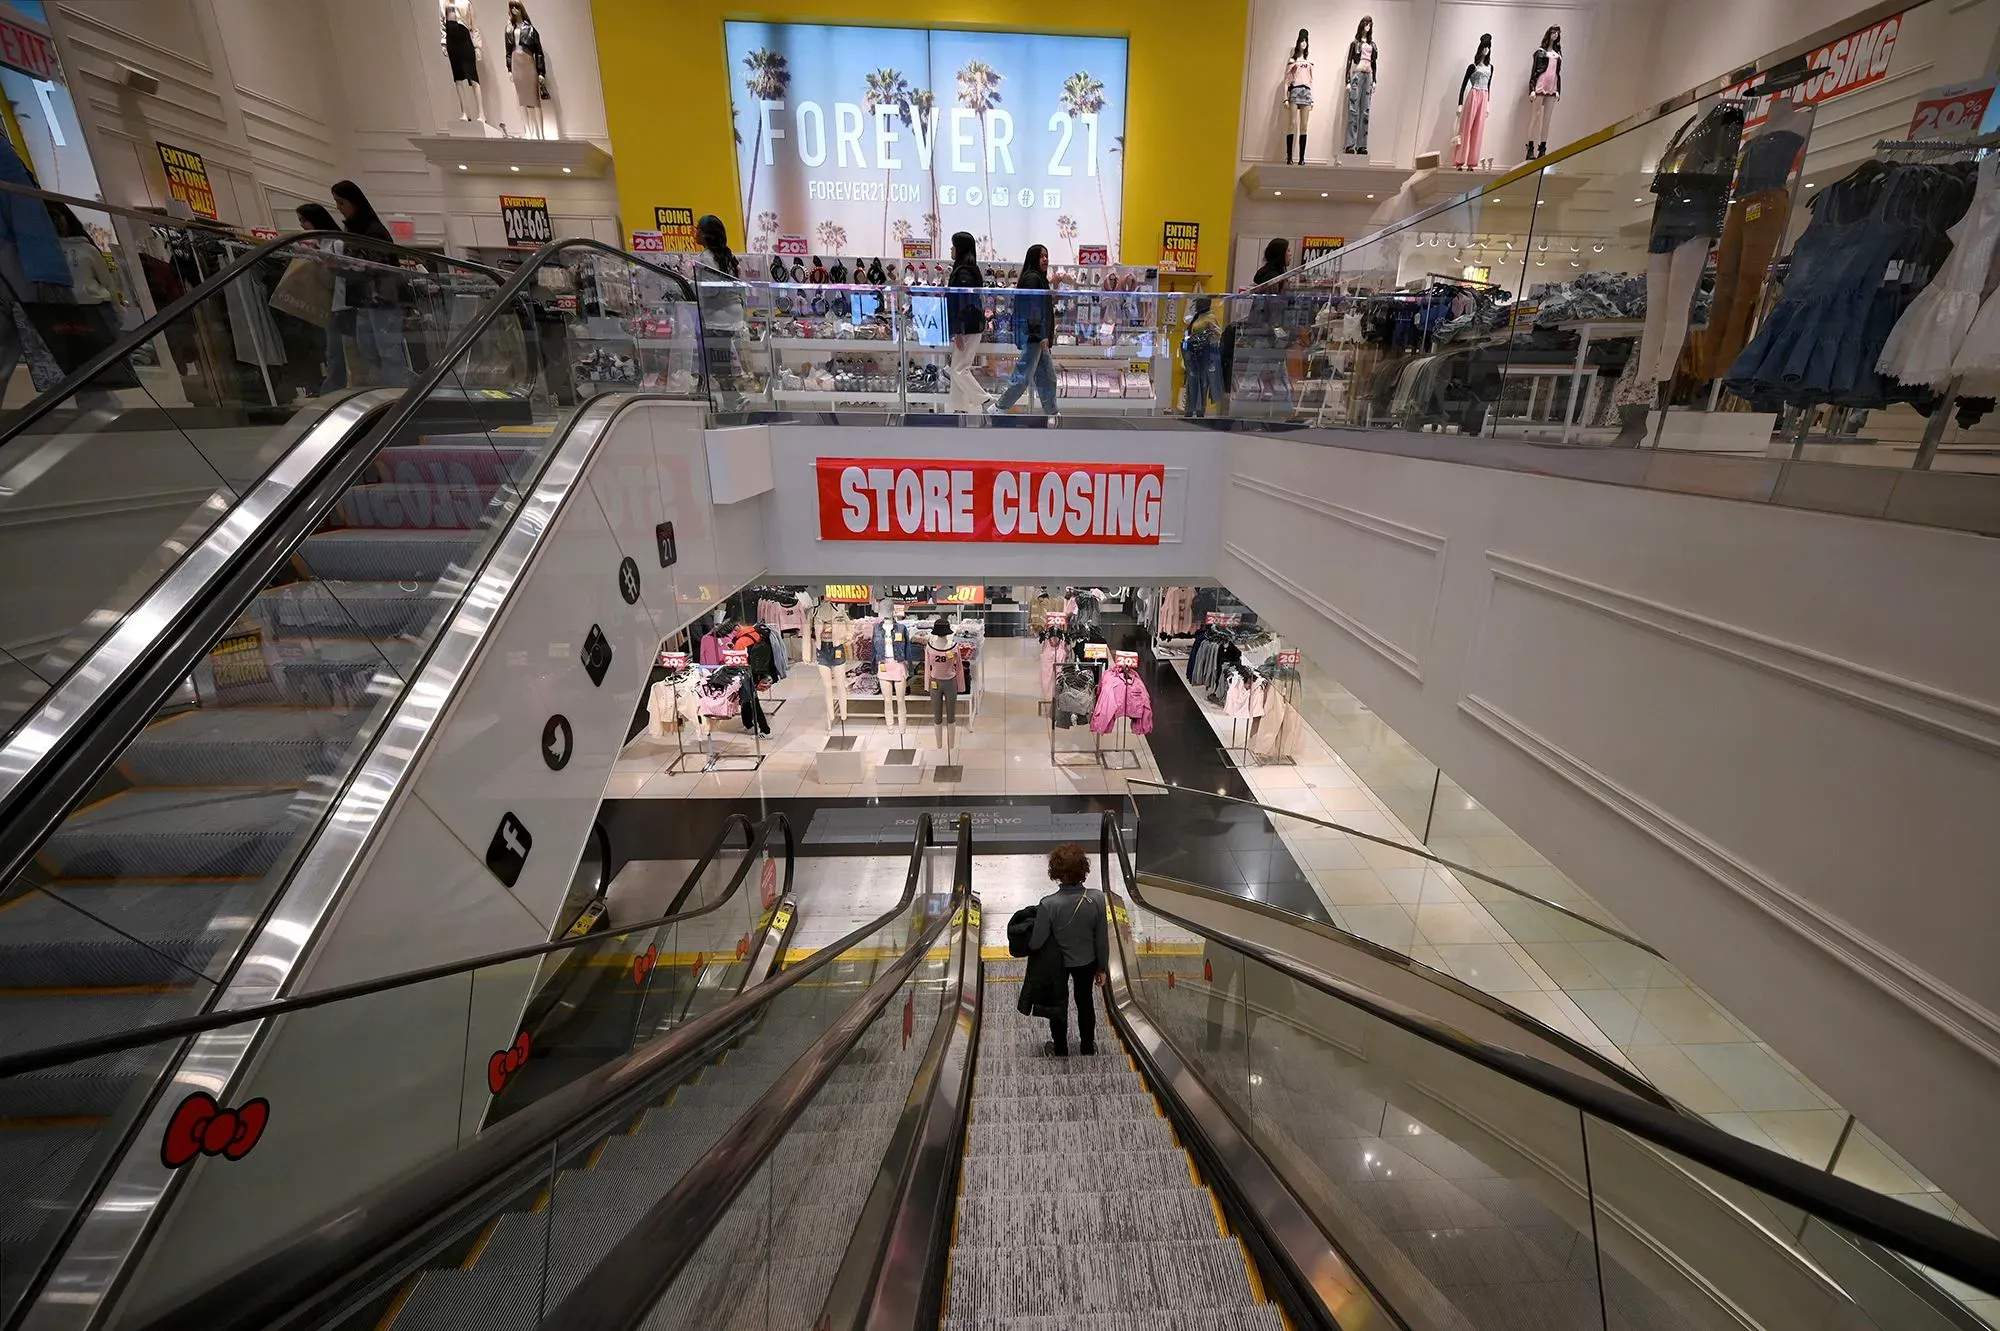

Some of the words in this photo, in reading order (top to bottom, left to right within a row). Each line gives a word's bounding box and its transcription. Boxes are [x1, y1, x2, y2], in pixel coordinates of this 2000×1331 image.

[0, 23, 50, 76] EXIT
[759, 99, 1016, 175] FOREVER
[1047, 111, 1099, 178] 21
[160, 146, 204, 173] ENTIRE
[168, 165, 209, 190] STORE
[808, 180, 921, 203] FOREVER21.COM
[189, 189, 216, 215] SALE!
[503, 197, 545, 208] EVERYTHING
[658, 209, 691, 224] GOING
[660, 224, 678, 235] OUT
[680, 225, 692, 235] OF
[1166, 224, 1197, 237] ENTIRE
[1166, 237, 1196, 250] STORE
[1176, 251, 1196, 268] SALE!
[1463, 266, 1489, 283] STORE
[840, 466, 974, 534] STORE
[992, 470, 1162, 538] CLOSING
[663, 538, 673, 560] 21
[935, 655, 947, 663] 28
